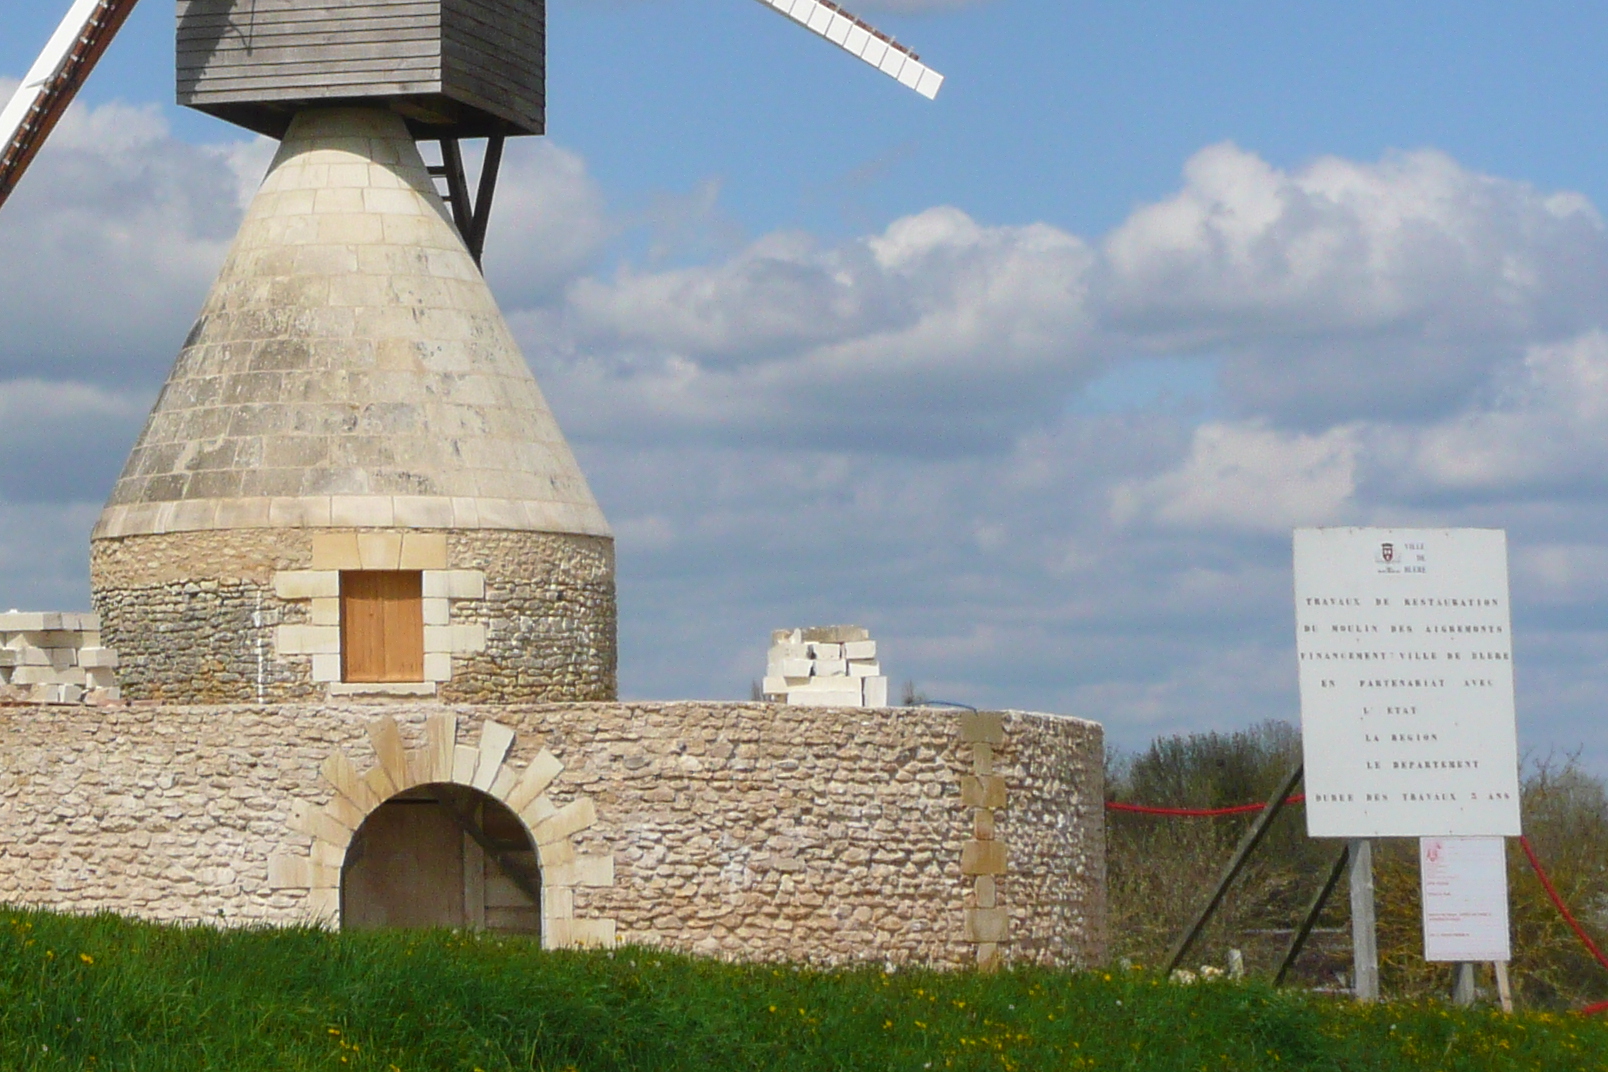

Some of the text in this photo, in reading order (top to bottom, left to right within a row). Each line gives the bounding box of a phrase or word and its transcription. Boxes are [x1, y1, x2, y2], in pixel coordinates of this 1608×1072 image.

[1305, 598, 1499, 607] TRAVAUX DE RESTAURATION
[1303, 624, 1503, 633] DU MOULIN DES AIGREMONTS
[1399, 652, 1437, 660] VILLE
[1447, 652, 1461, 660] DE
[1321, 679, 1493, 688] EN PARTENARIAT AVEC
[1387, 707, 1417, 715] ETAT
[1365, 733, 1438, 742] LA REGION
[1366, 761, 1479, 769] LE DEPARTEMENT
[1315, 794, 1354, 802] DUREE
[1366, 794, 1388, 802] DES
[1403, 793, 1457, 801] TRAVAUX
